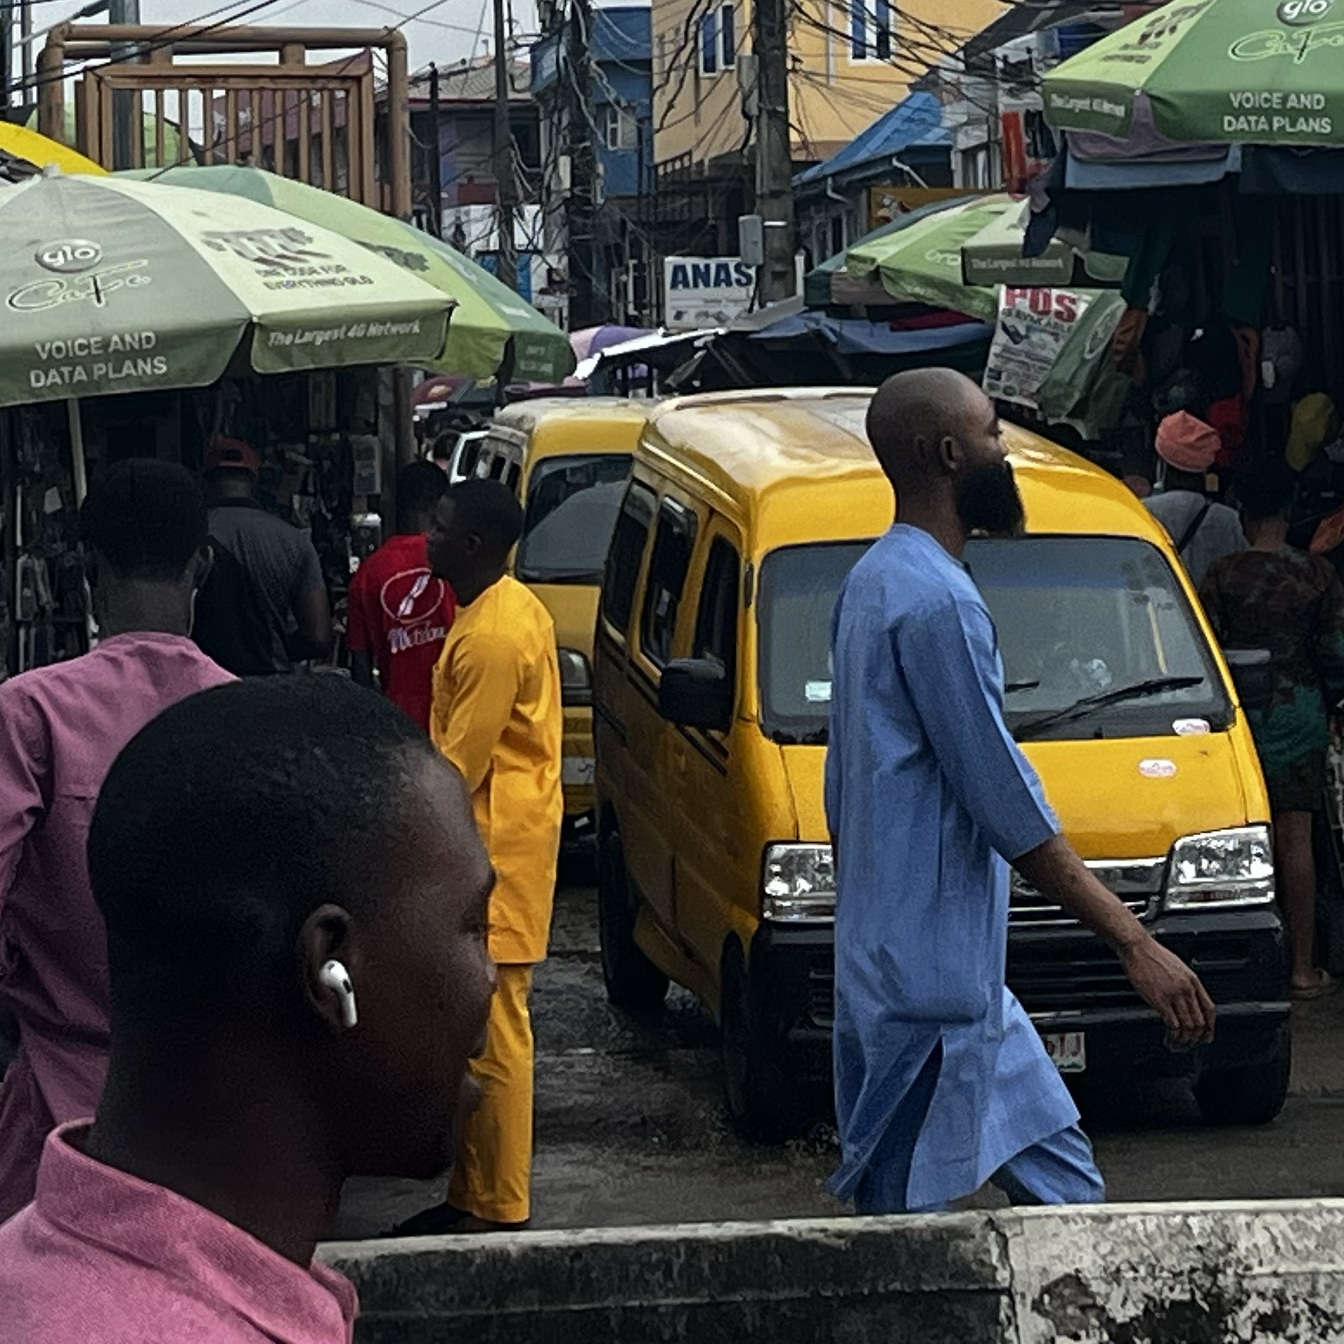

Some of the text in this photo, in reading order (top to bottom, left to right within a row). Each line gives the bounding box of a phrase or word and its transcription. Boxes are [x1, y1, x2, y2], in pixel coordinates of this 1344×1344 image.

[1229, 91, 1326, 110] VOICE AND
[1223, 115, 1332, 134] DATA PLANS
[669, 261, 753, 290] ANAS
[34, 331, 156, 360] VOICE AND
[267, 331, 294, 347] The
[294, 325, 346, 346] Largest
[367, 320, 420, 336] Network
[29, 356, 168, 388] DATA PLANS
